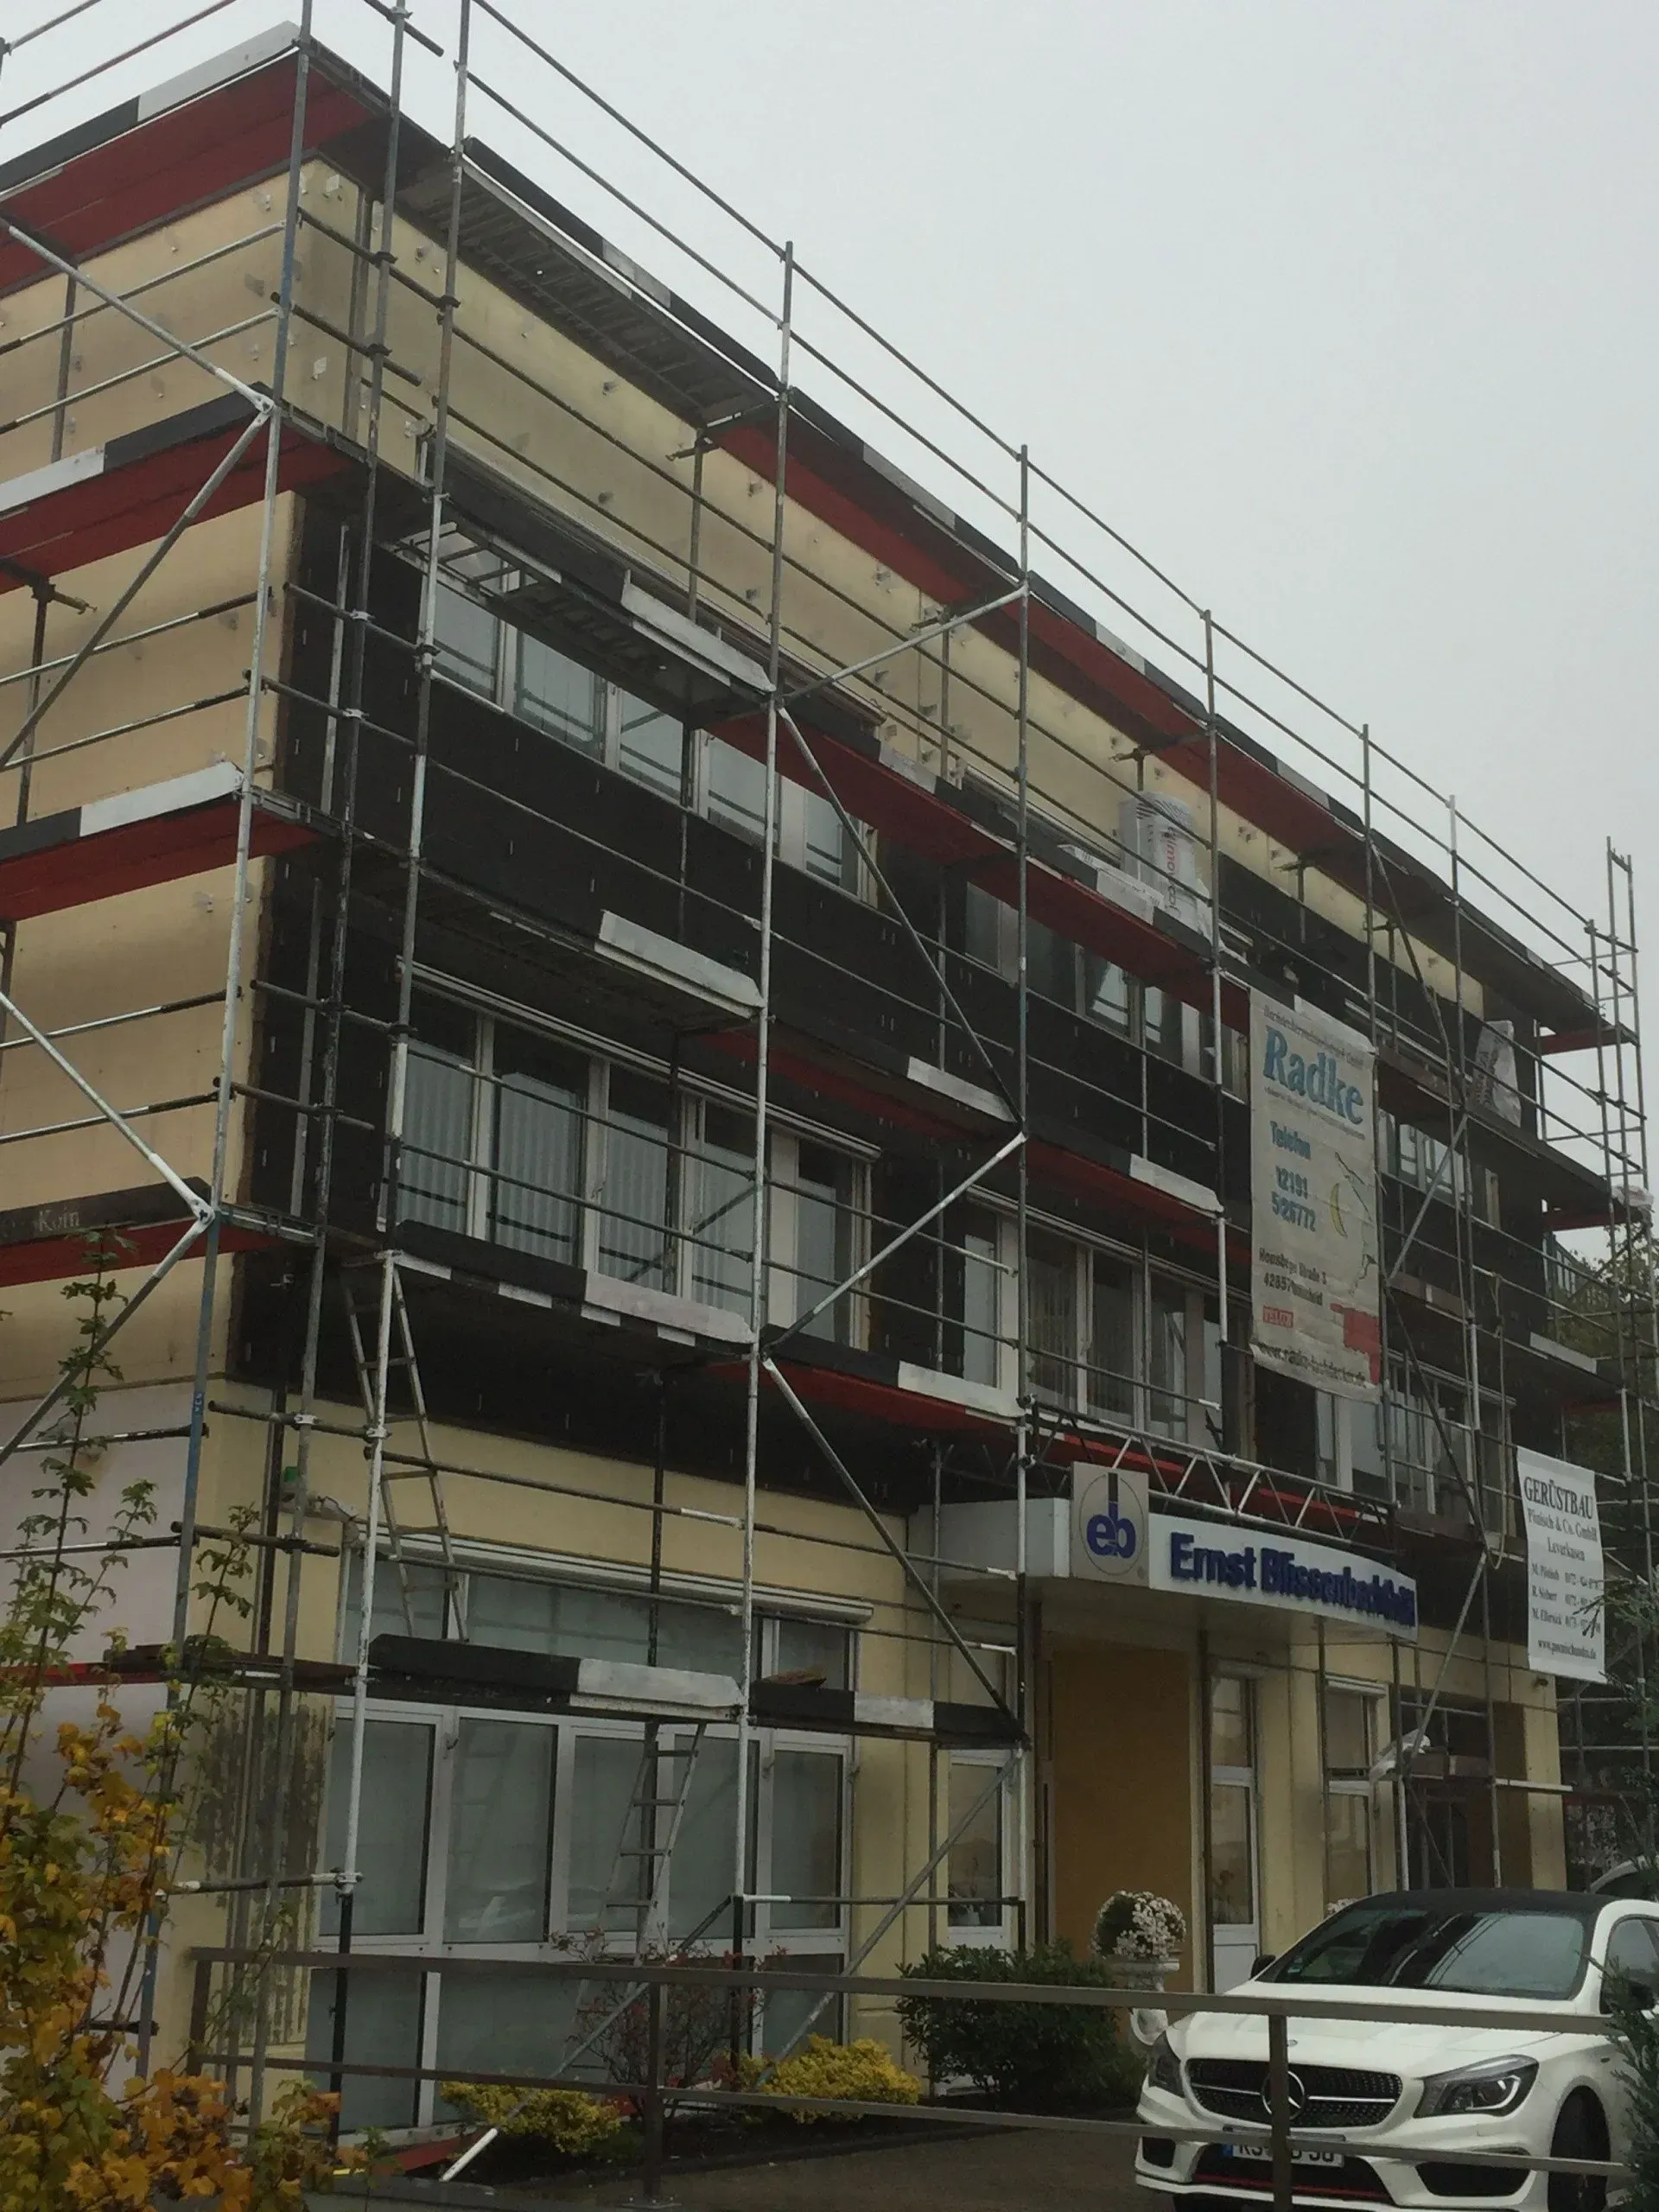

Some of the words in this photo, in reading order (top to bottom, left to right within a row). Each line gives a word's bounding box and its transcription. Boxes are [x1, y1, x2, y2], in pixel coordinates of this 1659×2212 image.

[1262, 1025, 1364, 1126] Radke
[1523, 1476, 1593, 1519] GERÜSTBAU
[1170, 1531, 1257, 1591] Ernst
[1547, 1536, 1586, 1561] Leverkusen
